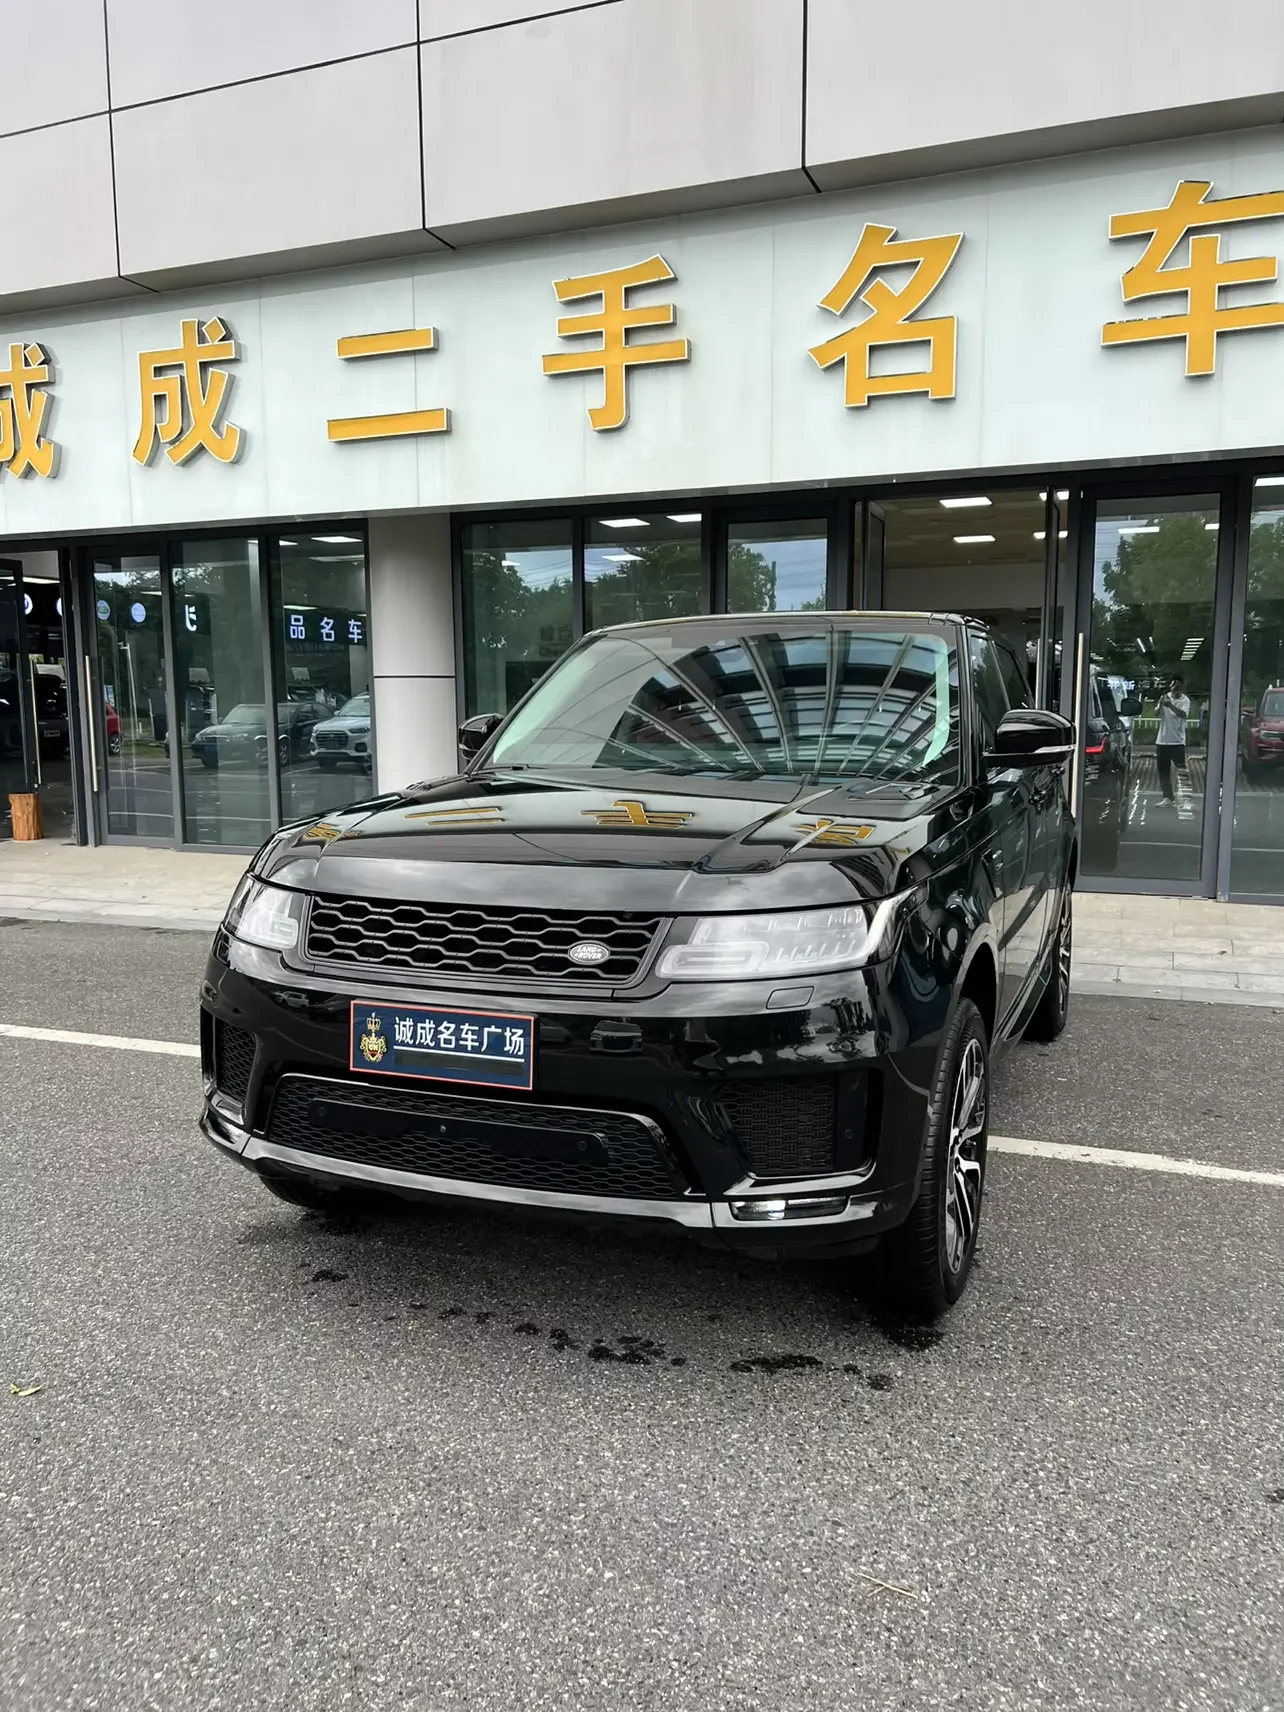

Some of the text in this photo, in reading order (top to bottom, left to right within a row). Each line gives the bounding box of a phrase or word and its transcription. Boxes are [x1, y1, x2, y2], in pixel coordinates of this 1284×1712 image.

[394, 1016, 525, 1056] 诚成名车广场
